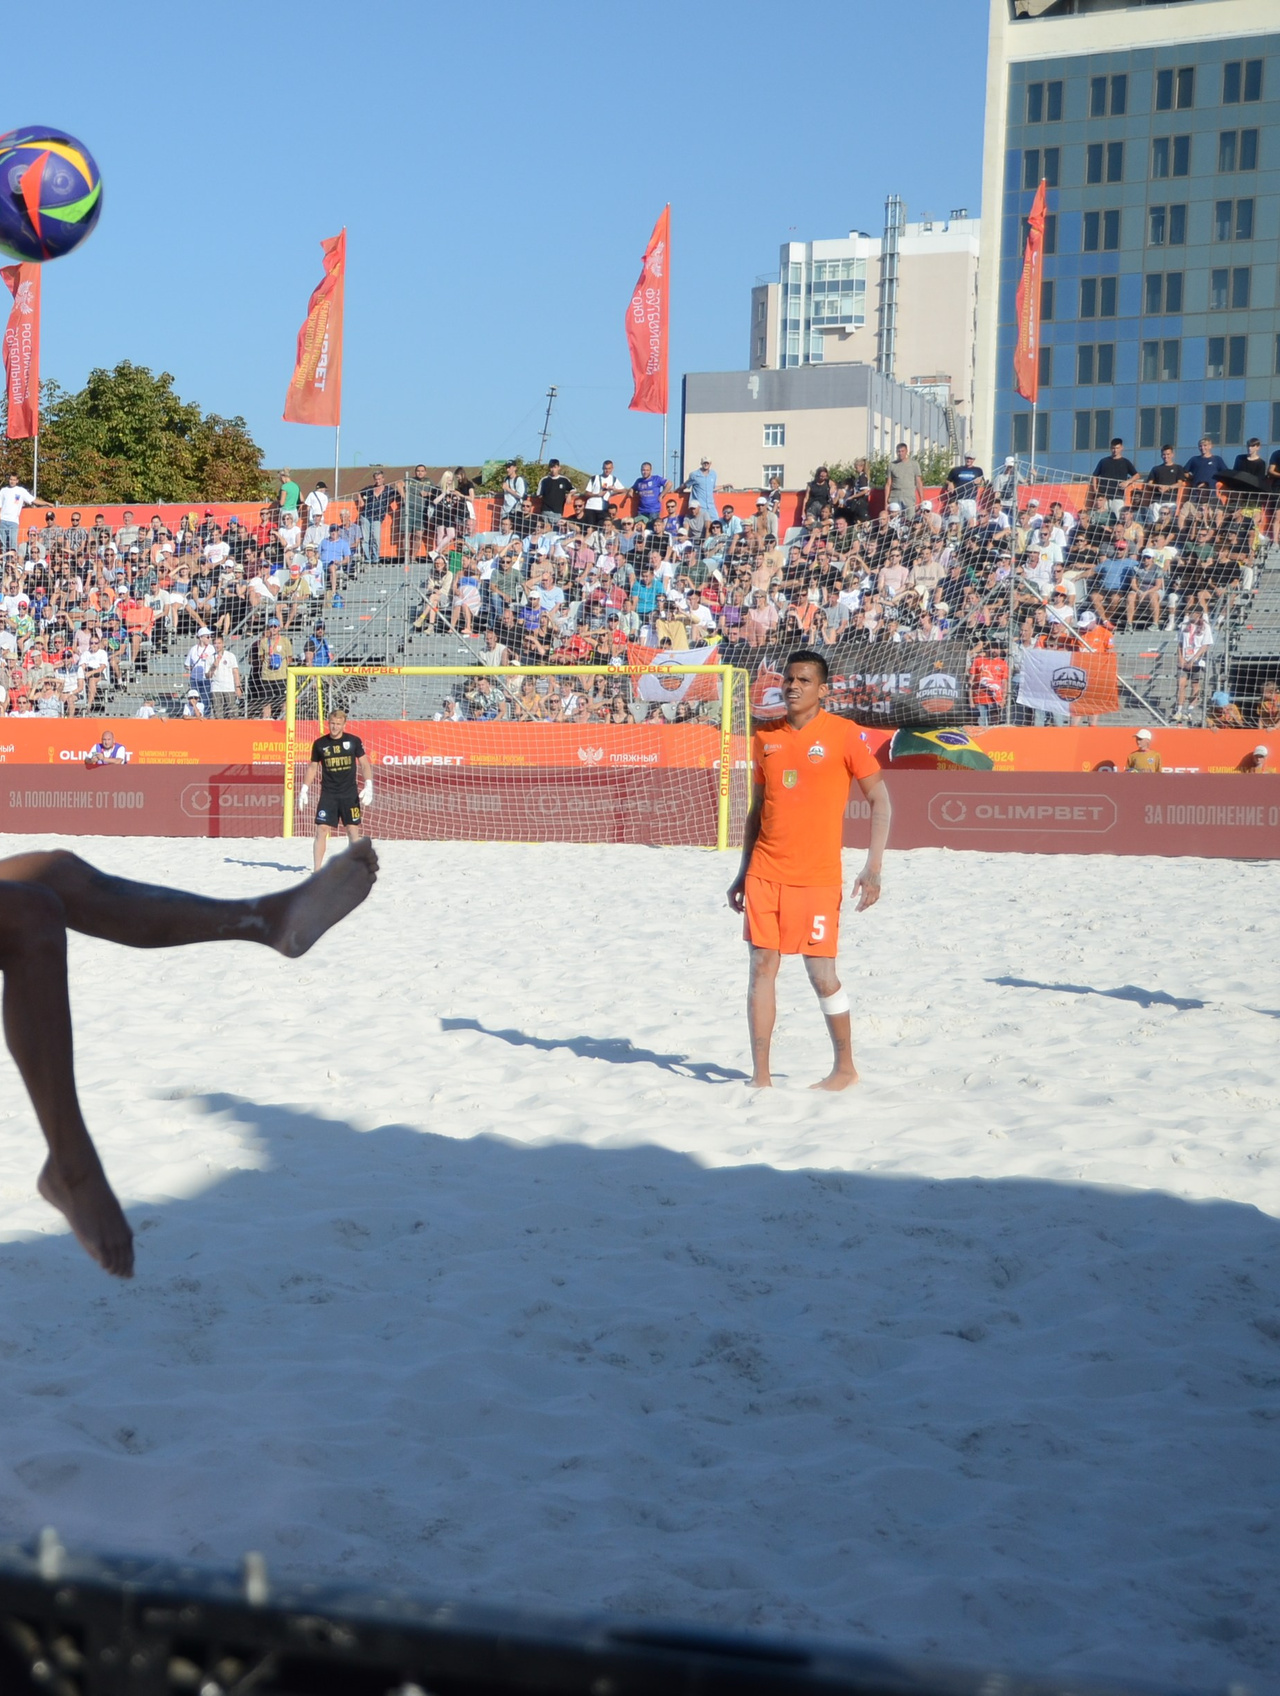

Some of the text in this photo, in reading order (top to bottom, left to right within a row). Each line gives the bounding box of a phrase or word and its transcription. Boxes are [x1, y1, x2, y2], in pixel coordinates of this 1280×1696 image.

[252, 742, 287, 752] САРАТО
[286, 728, 295, 790] OLIMPBET
[382, 755, 464, 765] OLIMPBET
[609, 753, 658, 763] ПЛЯЖНЫЙ
[720, 730, 731, 796] OLIMPBET
[987, 751, 1014, 762] 2024
[9, 791, 145, 808] ЗА ПОПОЛНЕНИЕ ОТ 1000
[218, 794, 285, 807] OLIMP
[975, 805, 1104, 820] OLIMPBET
[1145, 805, 1161, 824] ЗА
[1167, 805, 1265, 826] ПОПОЛНЕНИЕ
[810, 915, 826, 940] 5
